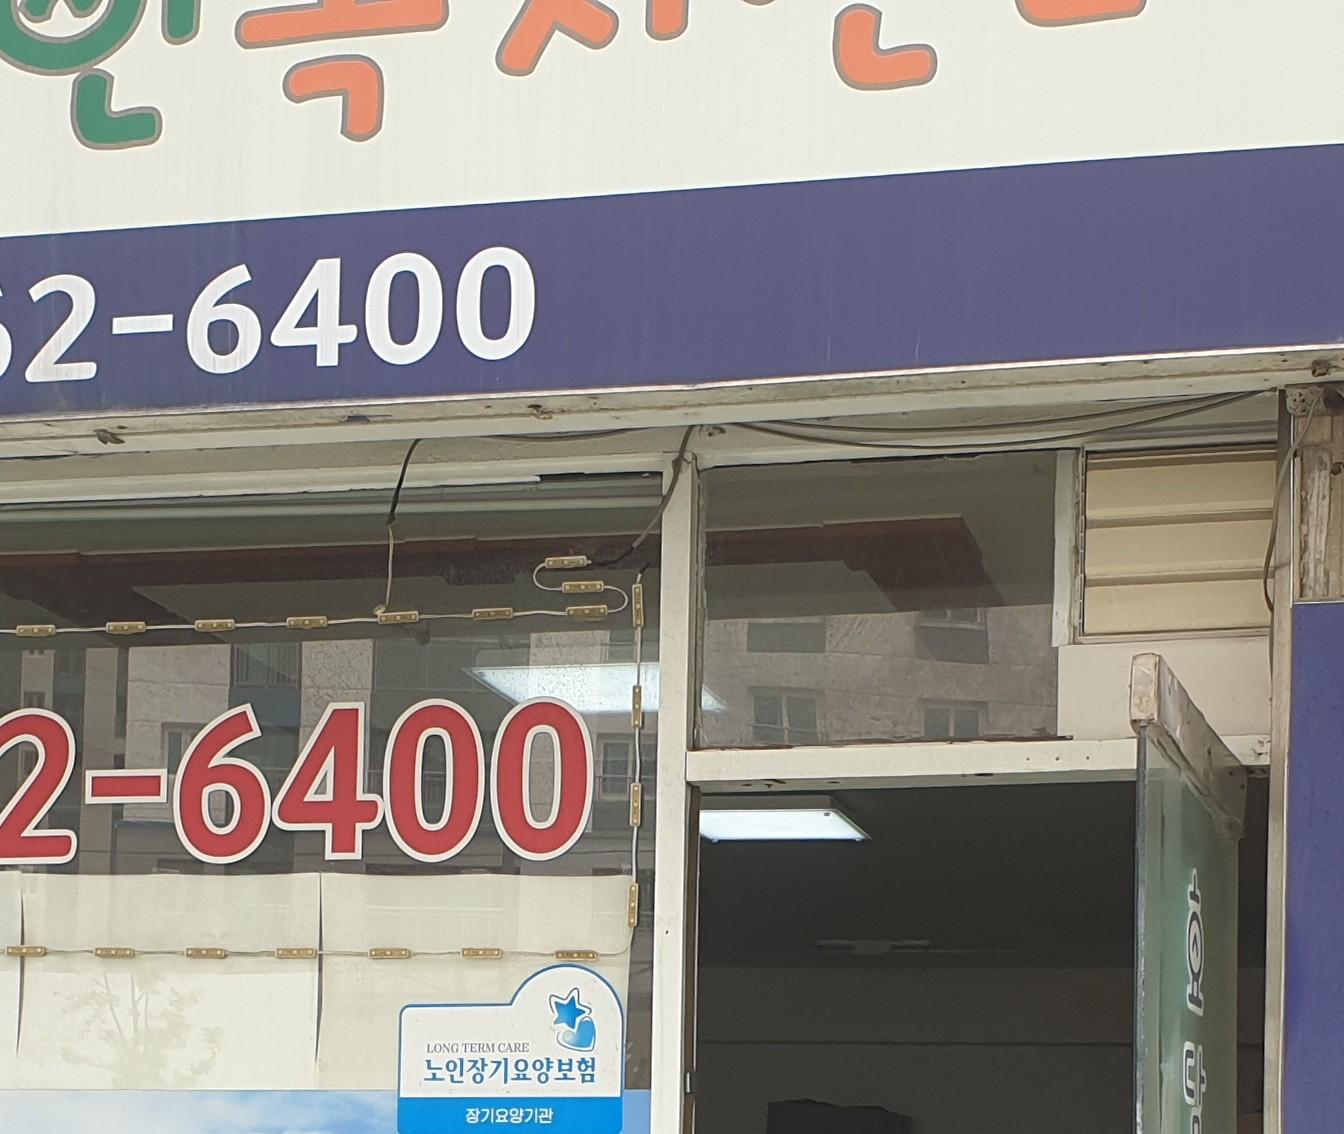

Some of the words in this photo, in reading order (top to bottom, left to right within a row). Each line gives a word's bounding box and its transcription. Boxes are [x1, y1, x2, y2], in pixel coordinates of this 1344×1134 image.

[426, 1043, 459, 1054] LONG
[462, 1043, 497, 1054] TERM
[498, 1042, 530, 1053] CARE
[423, 1057, 596, 1085] 노인장기요양보험
[465, 1107, 554, 1125] 장기요양기관
